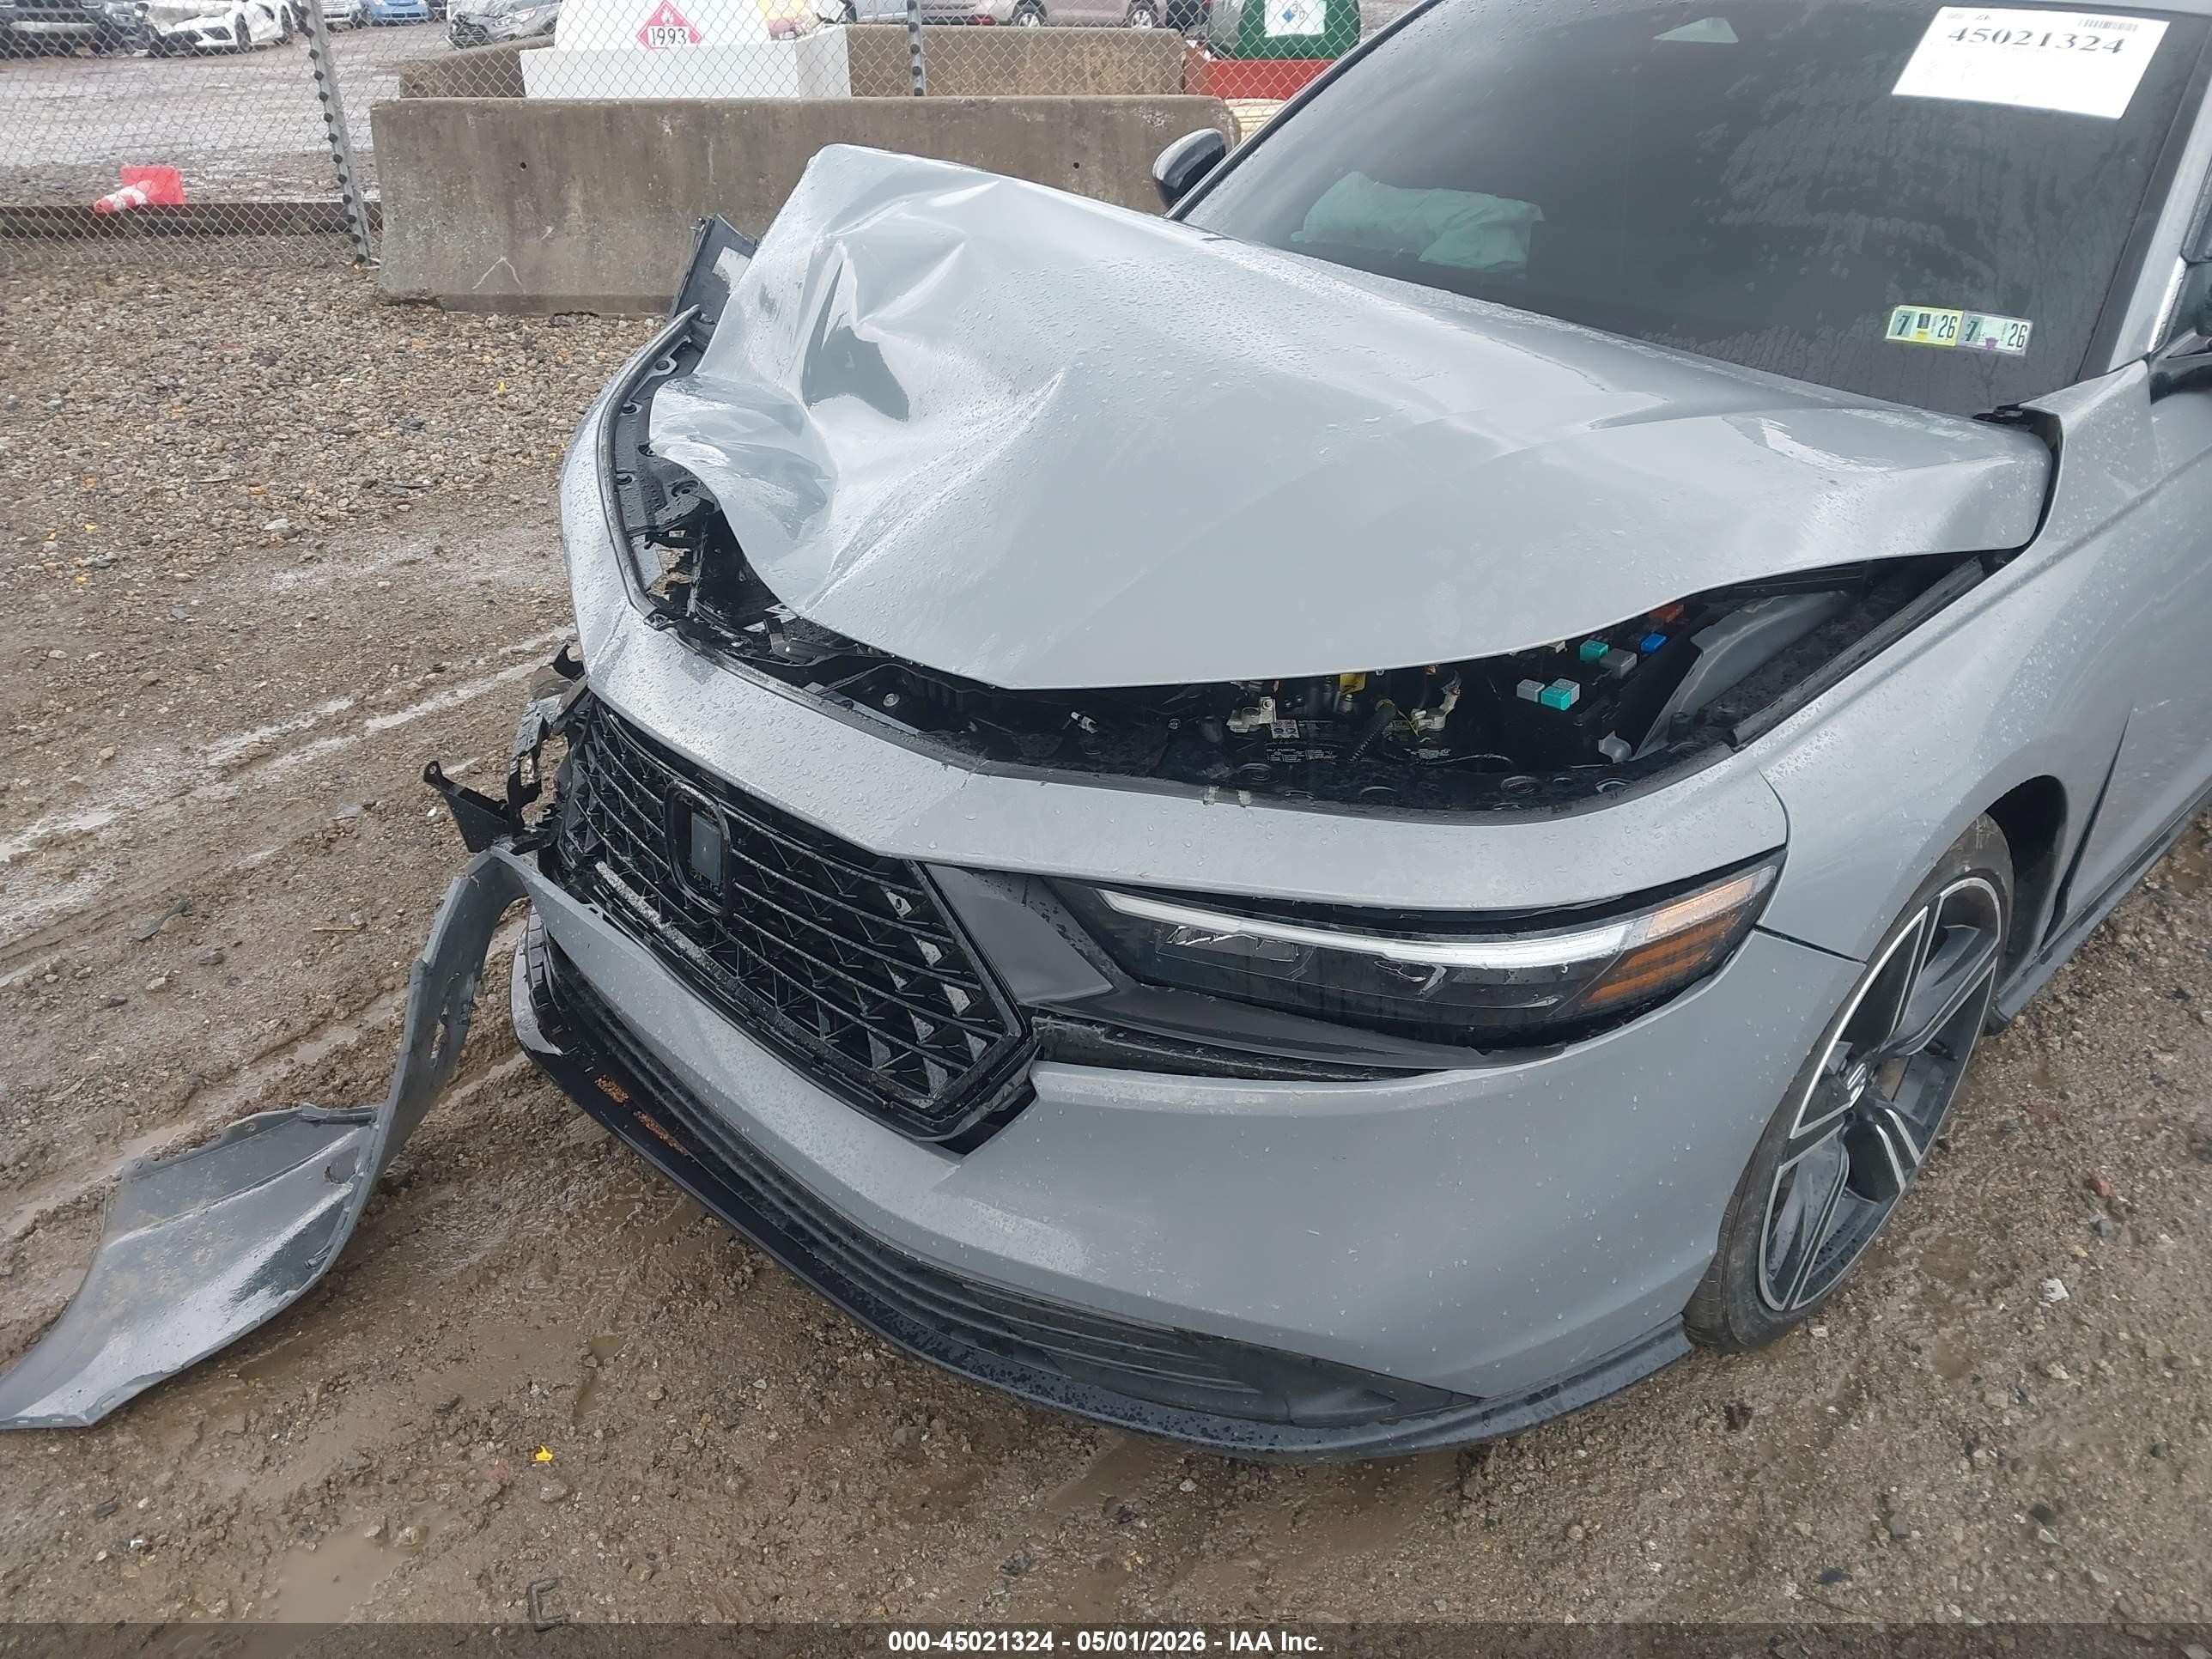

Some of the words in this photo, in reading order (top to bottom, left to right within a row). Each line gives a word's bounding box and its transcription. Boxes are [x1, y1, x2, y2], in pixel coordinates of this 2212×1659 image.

[651, 27, 687, 46] 1993
[1948, 27, 2125, 54] 45021324
[1897, 314, 1911, 336] 7
[1937, 314, 1958, 339] 26
[2007, 323, 2028, 349] 26
